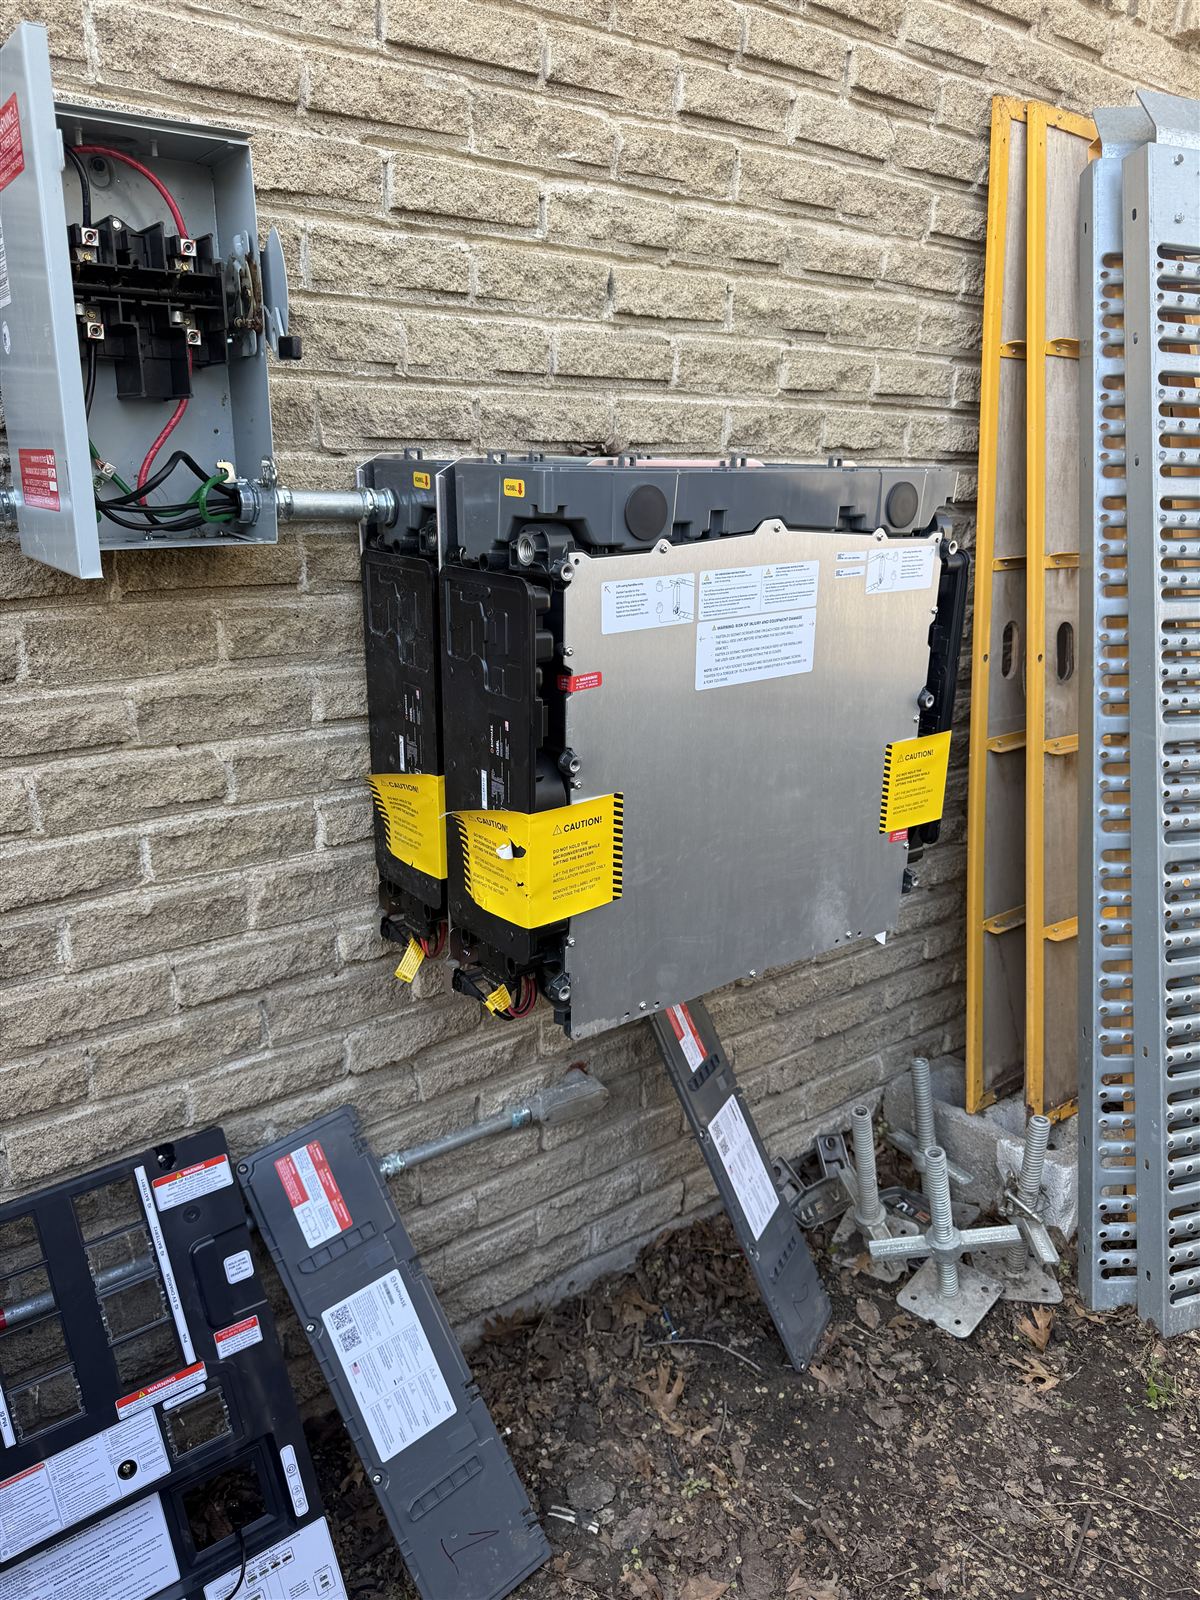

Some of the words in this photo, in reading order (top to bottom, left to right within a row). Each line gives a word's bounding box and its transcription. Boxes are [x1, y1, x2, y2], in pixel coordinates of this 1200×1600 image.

[905, 749, 934, 761] CAUTION!
[389, 780, 419, 794] CAUTION!
[476, 817, 509, 833] CAUTION!
[564, 815, 603, 833] CAUTION!
[553, 846, 587, 859] MICROINVERTERS
[553, 857, 569, 865] LIFTING
[577, 850, 594, 858] BATTERY
[182, 1163, 205, 1175] WARNING
[393, 1282, 407, 1308] ENPHASE
[146, 1375, 176, 1393] WARNING
